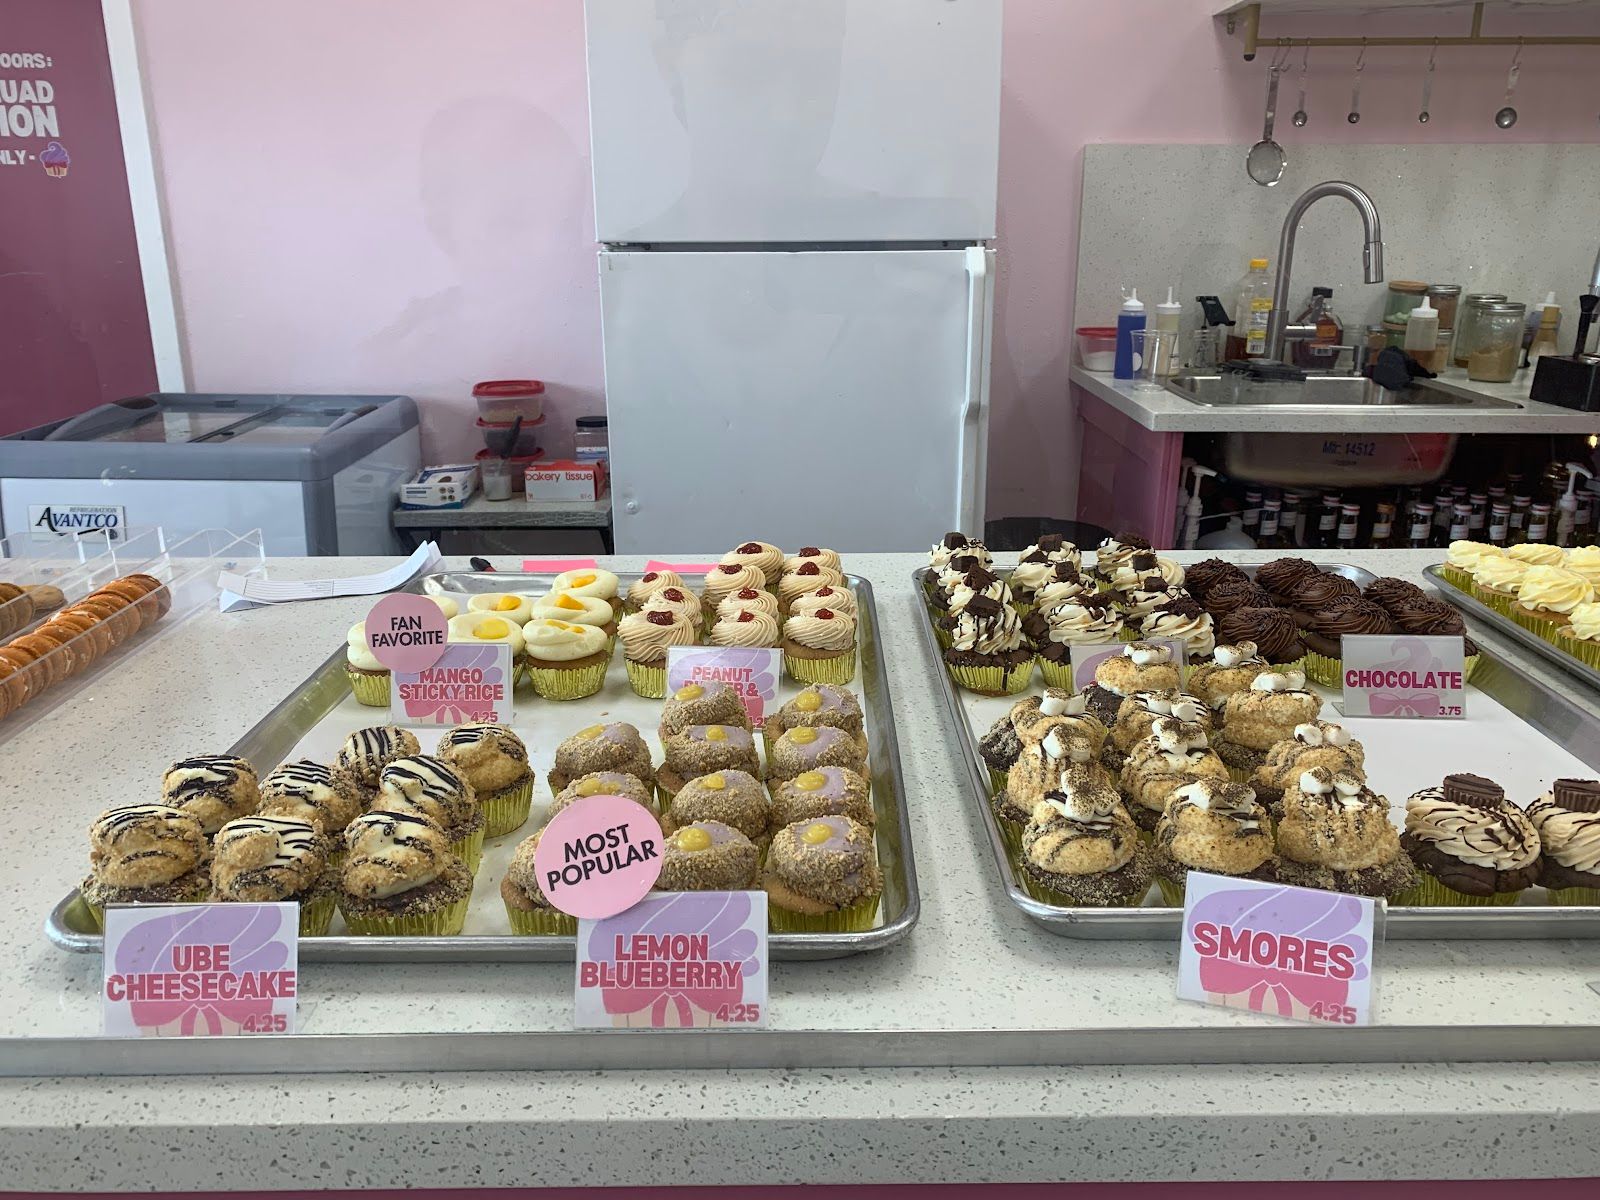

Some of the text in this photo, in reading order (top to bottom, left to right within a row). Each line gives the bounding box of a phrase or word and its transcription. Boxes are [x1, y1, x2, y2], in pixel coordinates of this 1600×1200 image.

[525, 471, 593, 483] bakery tissue
[35, 506, 118, 532] AVANTCO
[391, 615, 422, 631] FAN
[372, 630, 444, 647] FAVORITE
[419, 668, 483, 684] MANGO
[691, 666, 753, 683] PEANUT
[1345, 669, 1462, 689] CHOCOLATE
[399, 684, 504, 700] STICKY RICE
[470, 711, 499, 723] 425
[1438, 706, 1462, 716] 3.75
[564, 823, 630, 863] MOST
[546, 839, 659, 892] POPULAR
[615, 934, 709, 961] LEMON
[1193, 922, 1355, 980] SMORES
[172, 944, 230, 972] UBE
[580, 961, 743, 989] BLUEBERRY
[106, 971, 296, 1002] CHEESECAKE
[715, 1004, 760, 1023] 4.25
[1309, 1001, 1357, 1025] 4.25
[242, 1014, 288, 1033] 4.25
